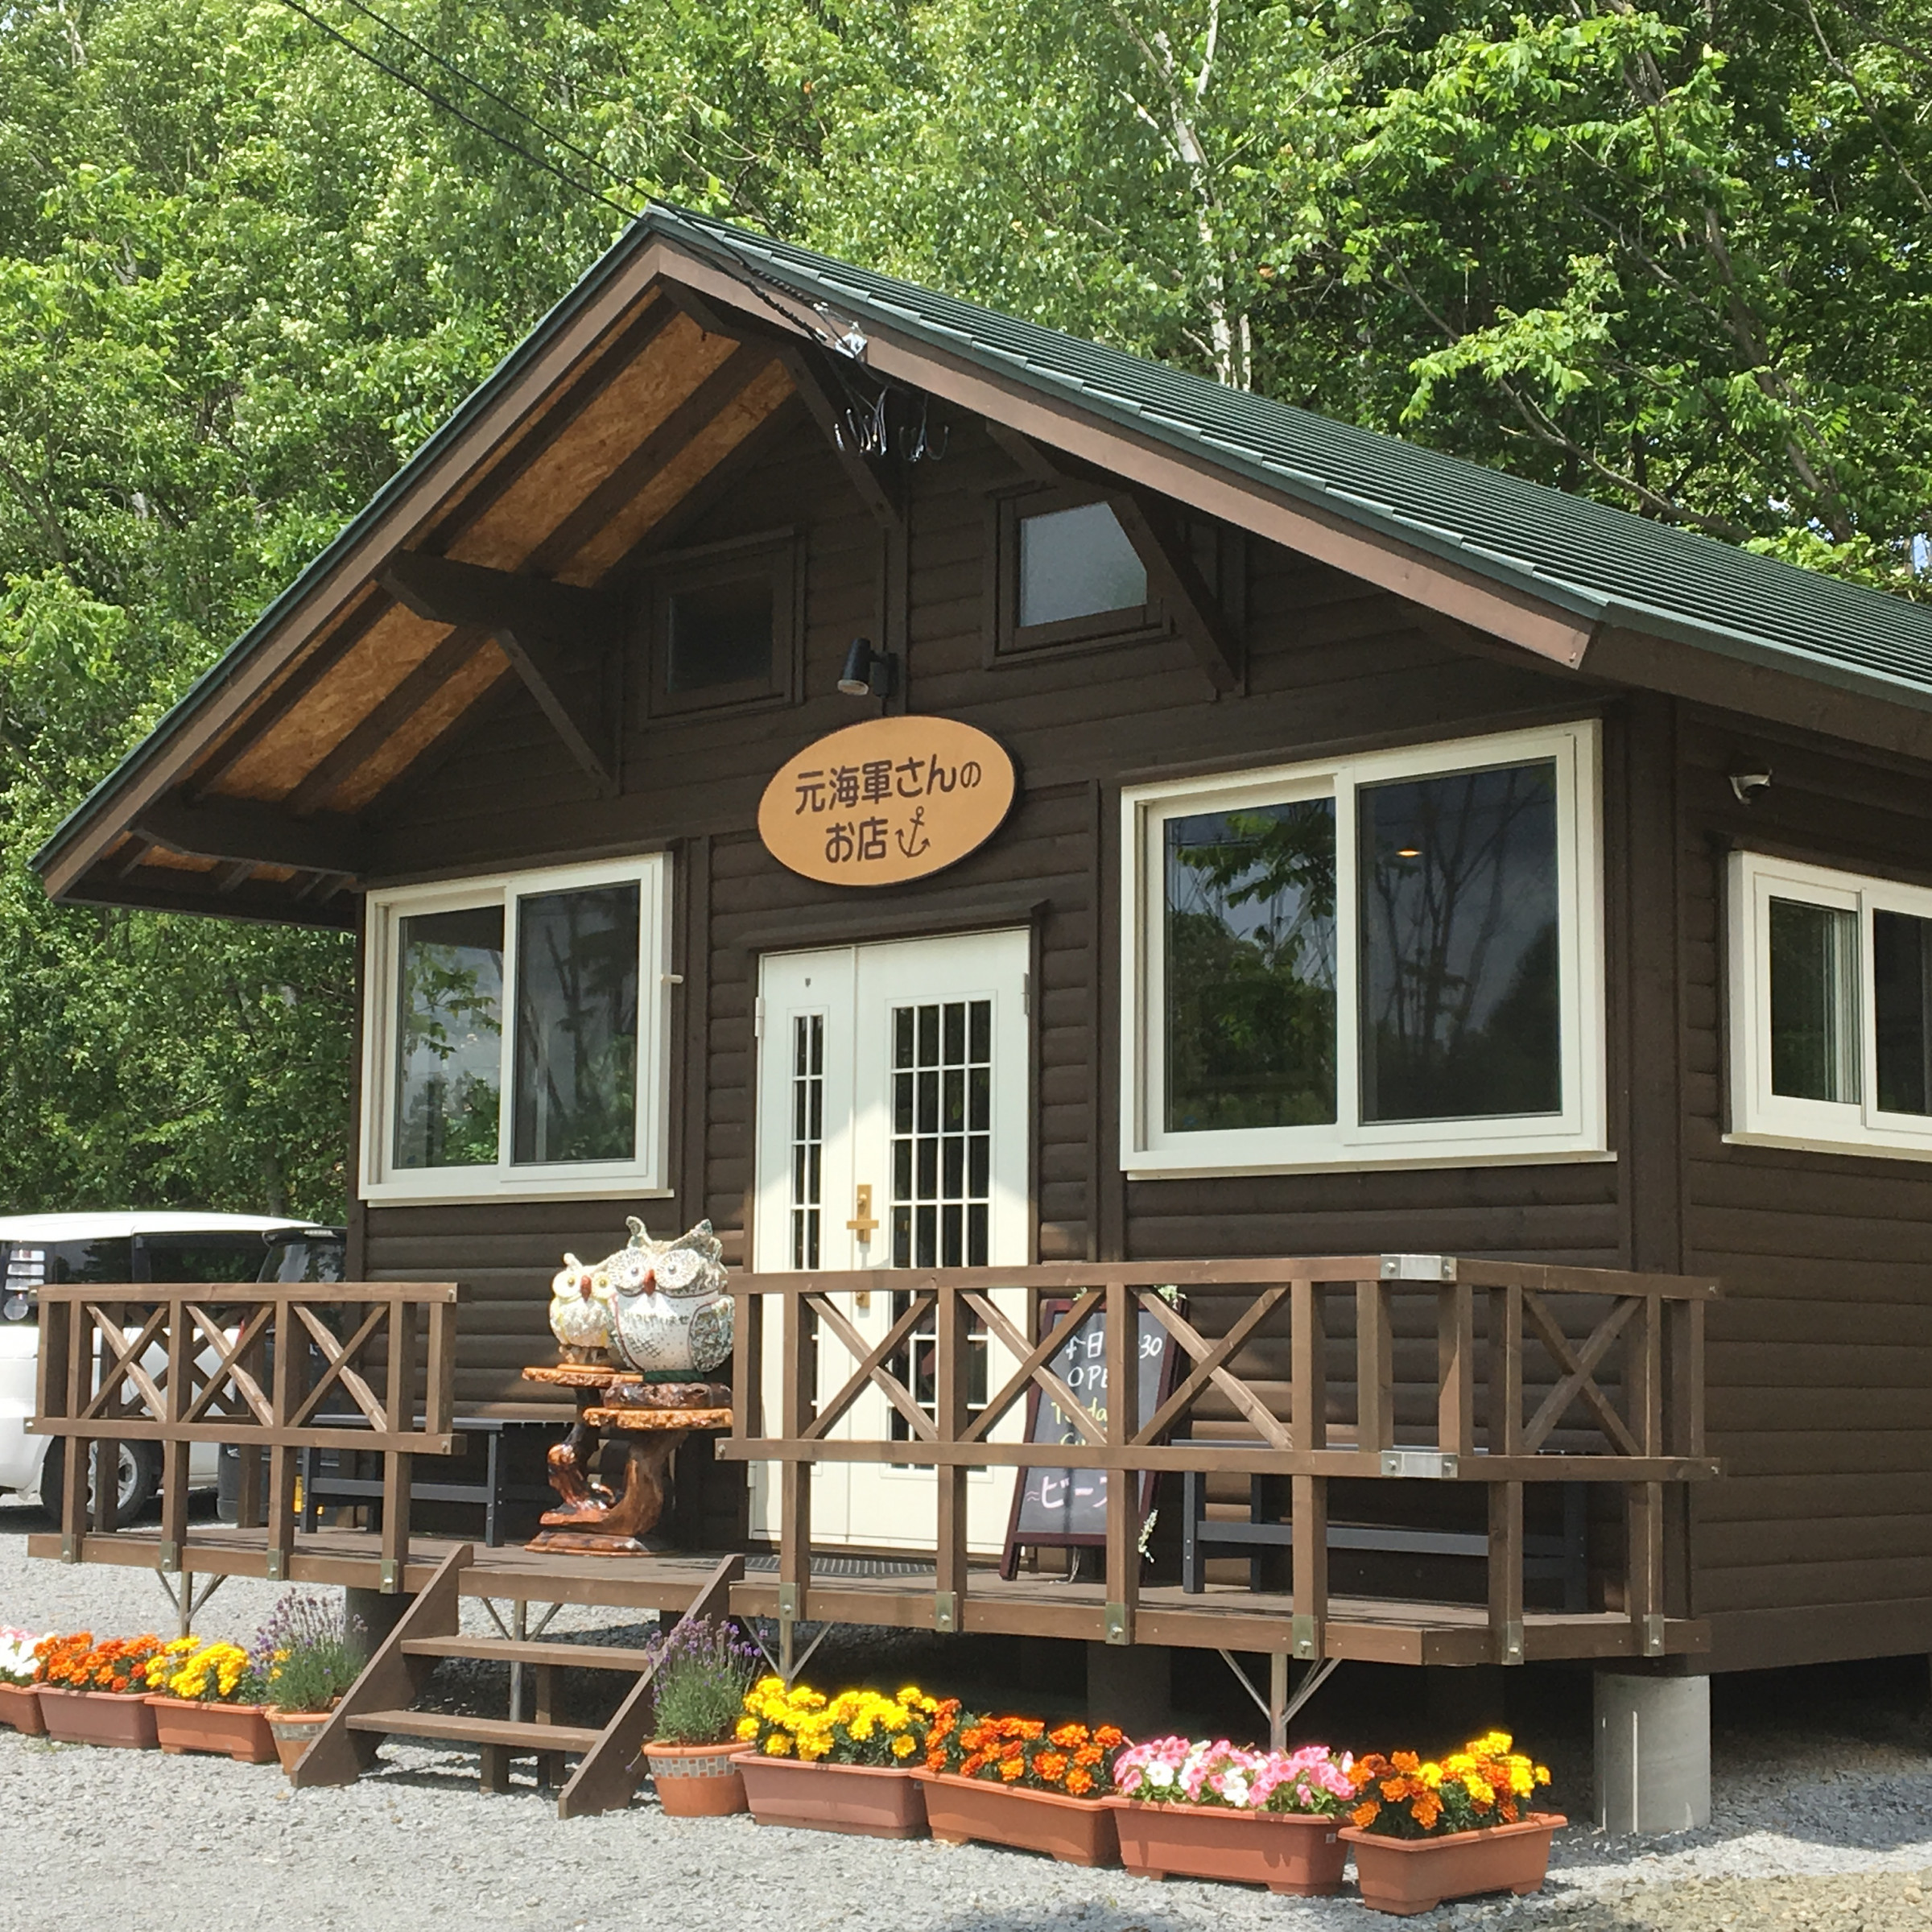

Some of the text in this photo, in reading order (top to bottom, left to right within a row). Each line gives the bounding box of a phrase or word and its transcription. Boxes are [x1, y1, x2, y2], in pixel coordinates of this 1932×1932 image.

[795, 754, 981, 815] 元海軍さんの
[825, 816, 888, 863] お店
